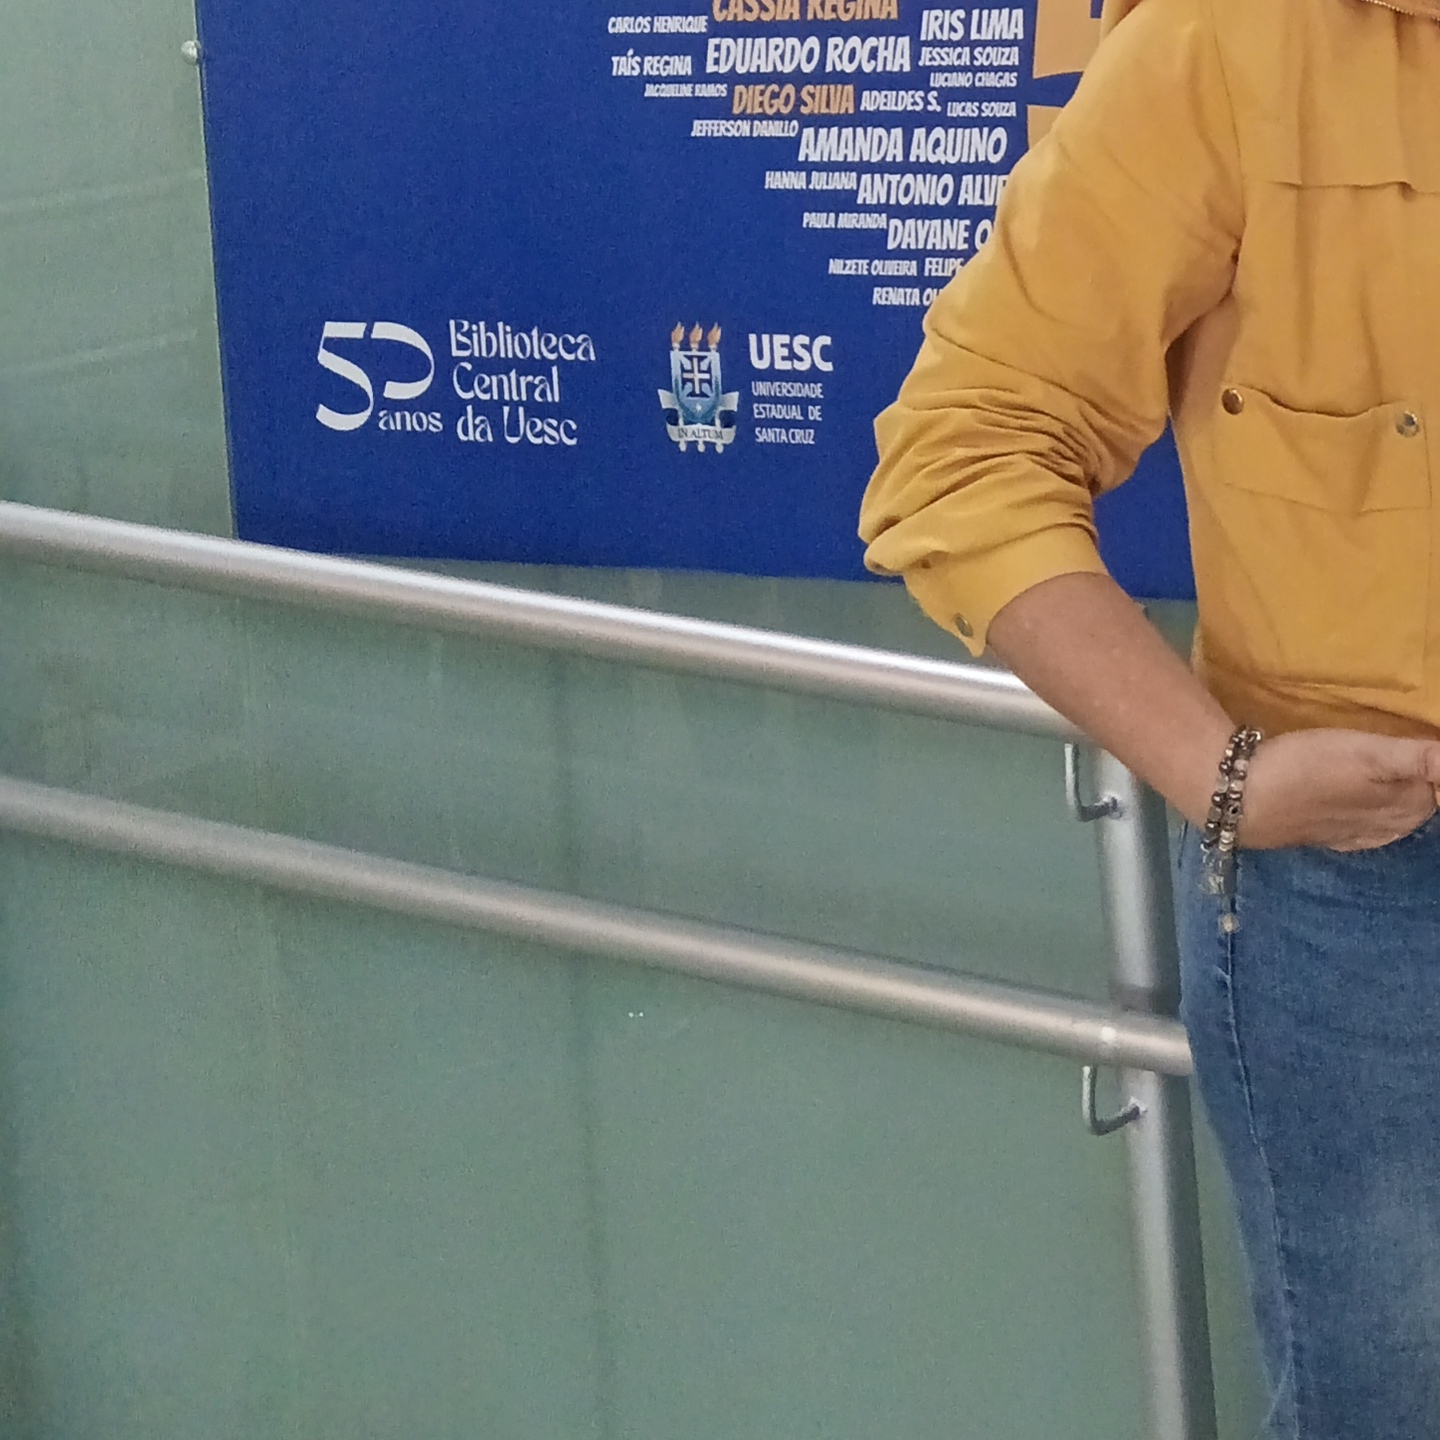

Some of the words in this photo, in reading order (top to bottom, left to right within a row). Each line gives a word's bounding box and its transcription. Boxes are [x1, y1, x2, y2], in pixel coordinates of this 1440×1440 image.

[706, 36, 820, 74] EDUARDO
[826, 36, 910, 73] ROCHA
[798, 127, 903, 162] AMANDA
[909, 127, 1007, 164] AQUINO
[450, 320, 595, 360] Biblioteca
[749, 334, 833, 371] UESC
[316, 322, 440, 432] 50
[453, 362, 559, 402] Central
[752, 382, 823, 398] UNIVERSIDADE
[379, 411, 443, 432] anos
[457, 406, 493, 442] da
[503, 406, 577, 445] Uesc
[753, 403, 804, 420] ESTADUAL
[808, 406, 822, 421] DE
[678, 426, 688, 439] IN
[691, 427, 723, 440] ALTUM
[755, 428, 788, 443] SANTA
[789, 429, 814, 444] CRUZ
